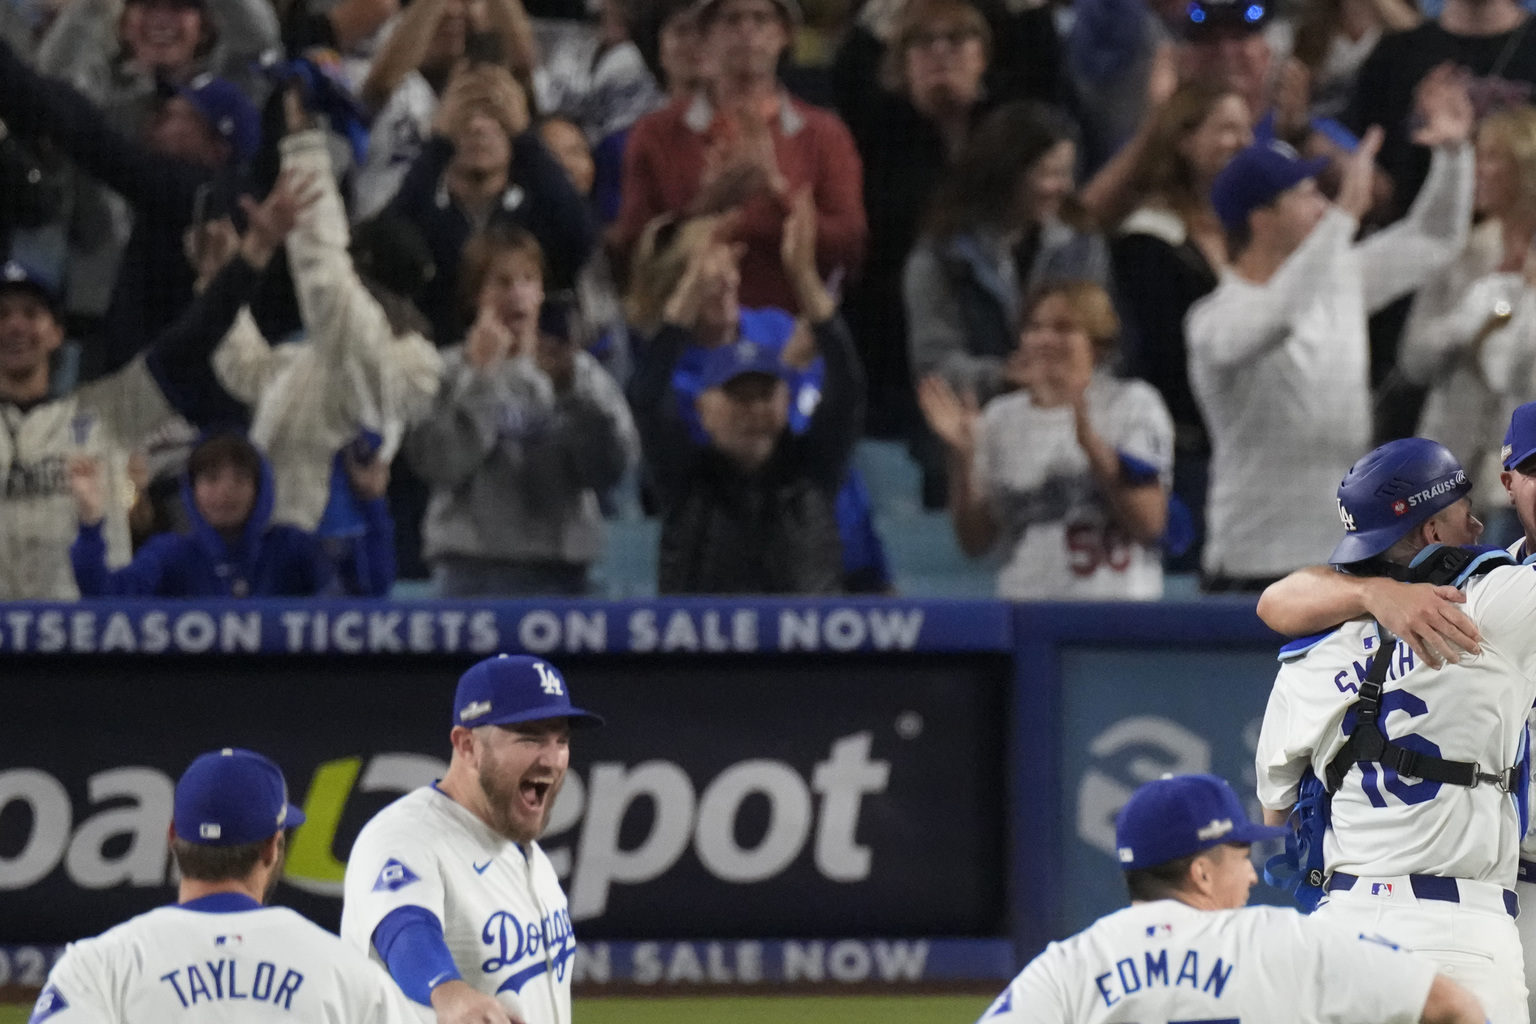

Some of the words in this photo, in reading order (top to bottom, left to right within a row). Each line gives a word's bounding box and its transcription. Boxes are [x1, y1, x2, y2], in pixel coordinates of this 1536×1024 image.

[1408, 478, 1456, 507] STRAUSS
[0, 610, 262, 653] TSEASON
[281, 610, 499, 653] TICKETS
[518, 609, 607, 652] ON
[628, 609, 758, 652] SALE
[778, 609, 925, 651] NOW
[532, 663, 563, 695] LA
[1341, 688, 1444, 808] 16
[633, 940, 769, 982] SALE
[782, 940, 931, 982] NOW
[1095, 948, 1233, 1008] EDMAN
[160, 959, 305, 1012] TAYLOR
